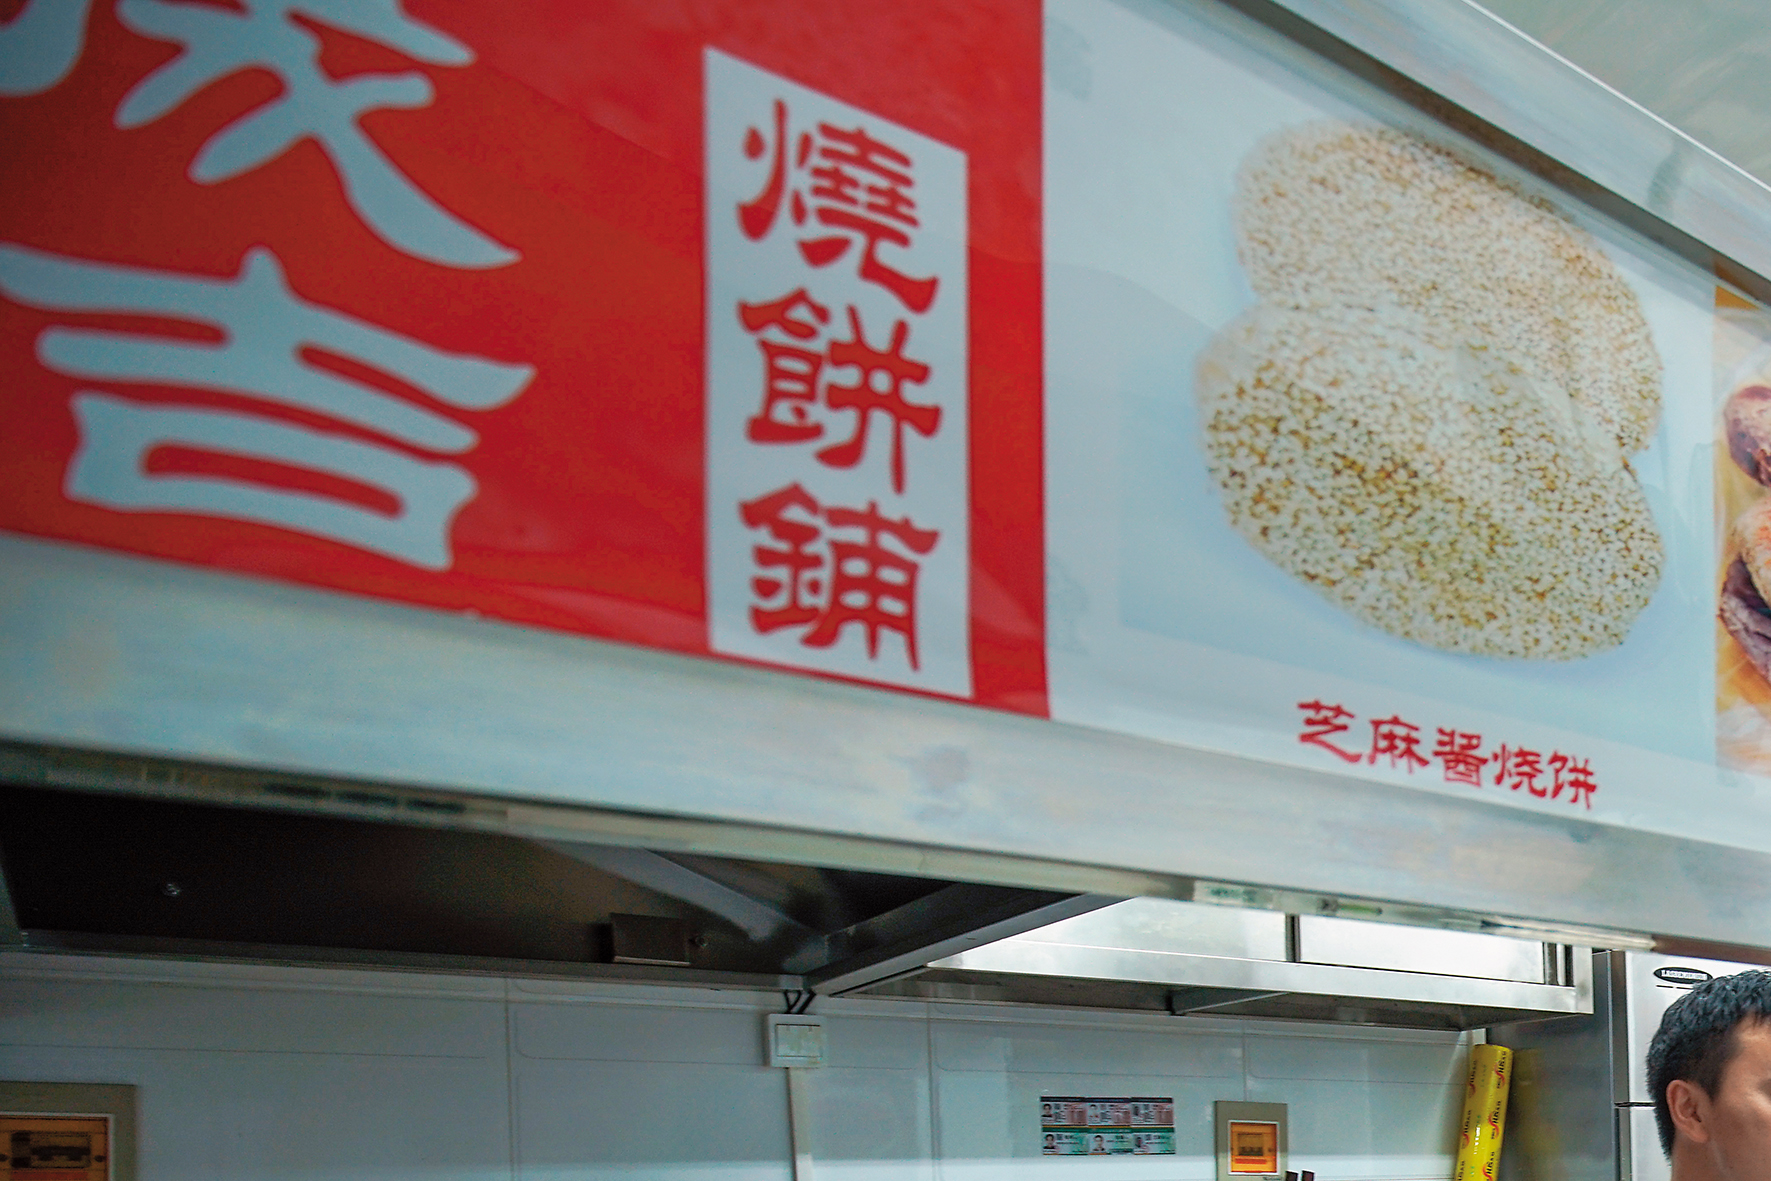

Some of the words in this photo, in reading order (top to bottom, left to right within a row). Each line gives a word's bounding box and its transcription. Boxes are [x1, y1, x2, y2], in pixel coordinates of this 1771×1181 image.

[1297, 699, 1597, 810] 芝麻酱烧饼
